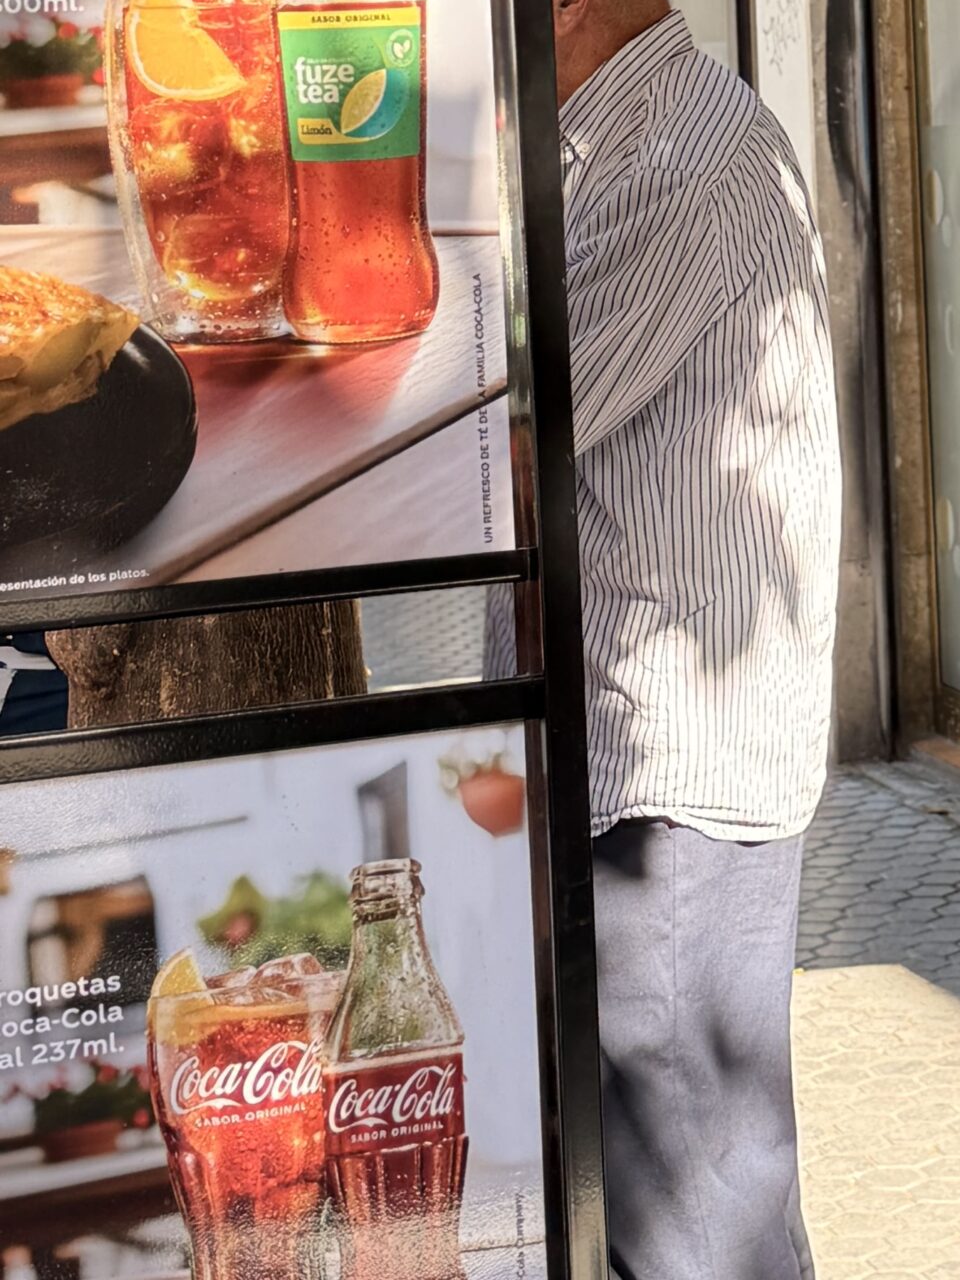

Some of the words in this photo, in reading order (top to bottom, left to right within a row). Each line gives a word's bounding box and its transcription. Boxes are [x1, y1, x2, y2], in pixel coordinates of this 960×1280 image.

[294, 57, 355, 84] fuze
[296, 81, 340, 104] tea
[300, 124, 333, 136] Limón
[472, 272, 484, 340] COCA-COLA
[476, 342, 486, 388] FAMILIA
[478, 407, 488, 424] DE
[478, 427, 488, 441] TÉ
[480, 443, 490, 460] DE
[481, 462, 492, 524] REFRESCO
[484, 526, 494, 544] UN
[69, 574, 85, 585] de
[88, 572, 107, 583] los
[109, 568, 151, 583] platos.
[31, 1032, 125, 1065] 237ml.
[170, 1039, 325, 1115] Coca-Cola
[328, 1062, 457, 1134] Coca-Cola
[194, 1114, 239, 1128] SABOR
[244, 1101, 307, 1122] ORIGINAL
[350, 1129, 387, 1143] SABOR
[391, 1121, 444, 1137] ORIGINAL
